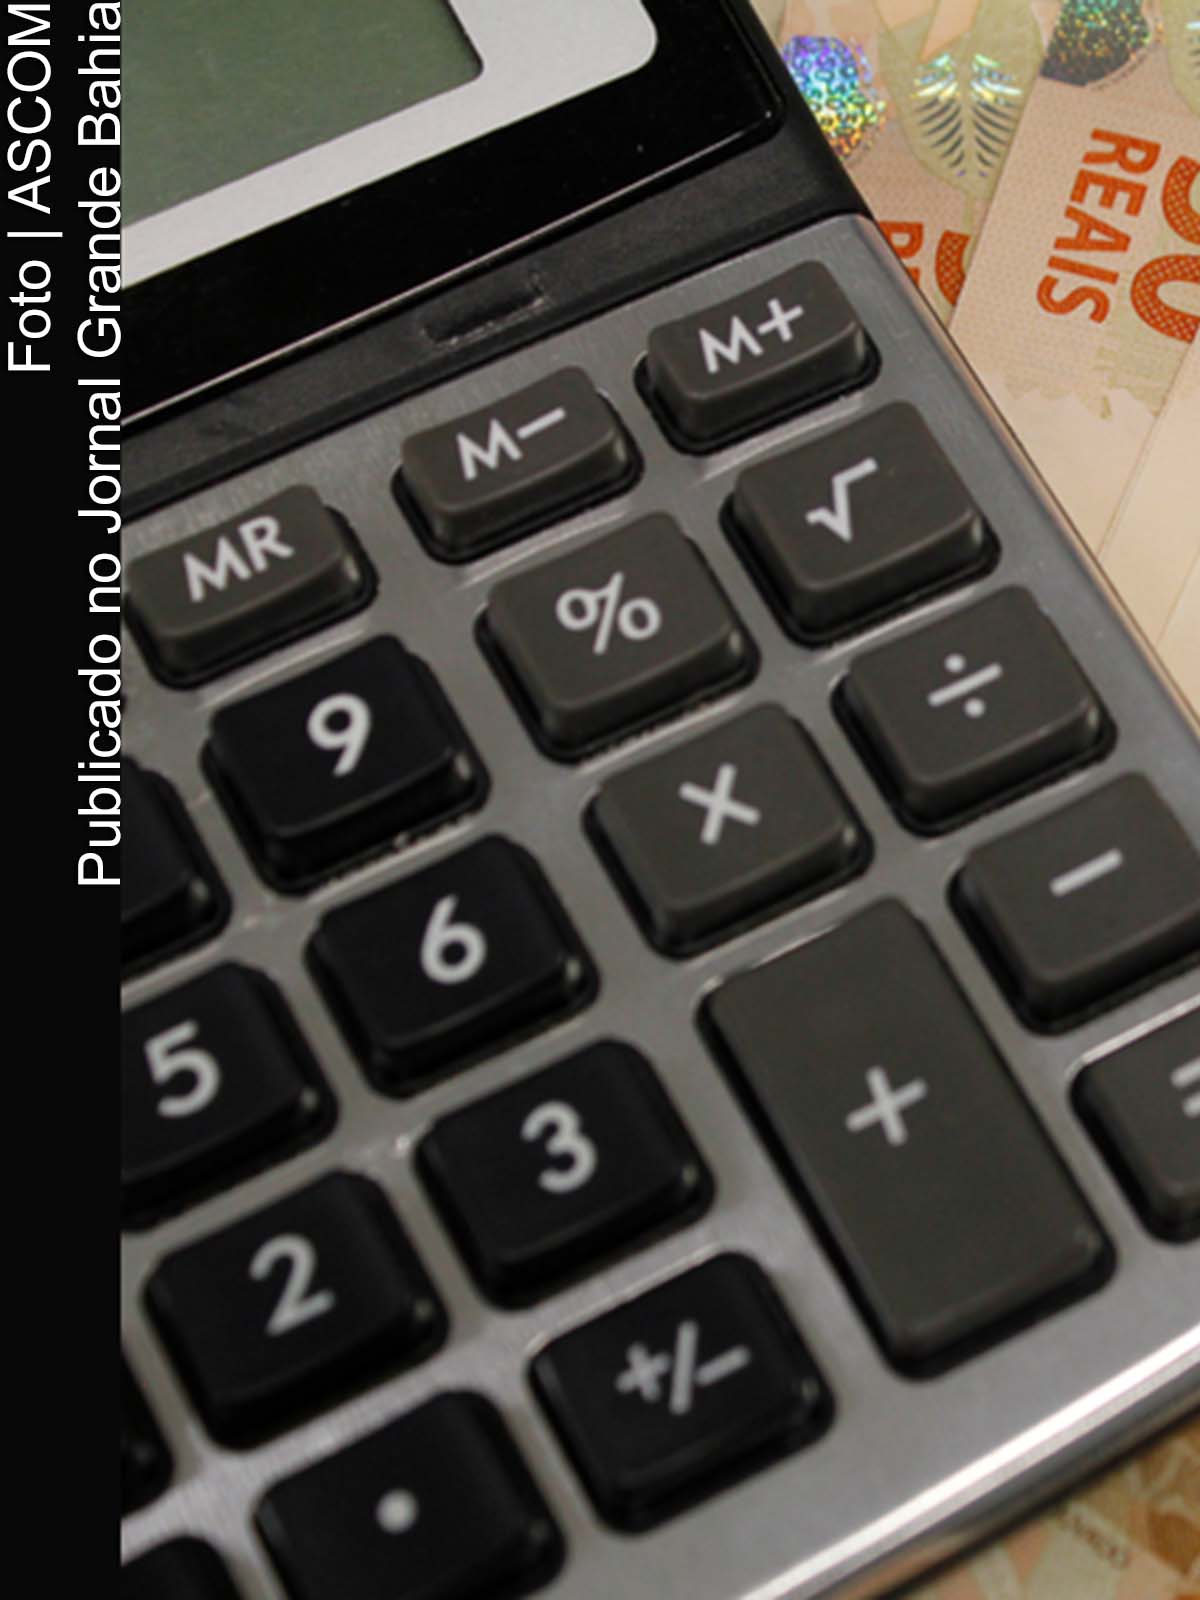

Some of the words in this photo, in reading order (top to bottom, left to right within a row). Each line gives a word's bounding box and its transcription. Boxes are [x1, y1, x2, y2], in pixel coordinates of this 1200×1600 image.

[1036, 128, 1161, 324] REAIS
[697, 297, 804, 374] M+
[182, 514, 293, 601] MR
[555, 571, 661, 654] %
[307, 692, 371, 776] 9
[420, 896, 486, 984] 6
[144, 1021, 222, 1118] 5
[520, 1101, 598, 1193] 3
[249, 1233, 337, 1337] 2
